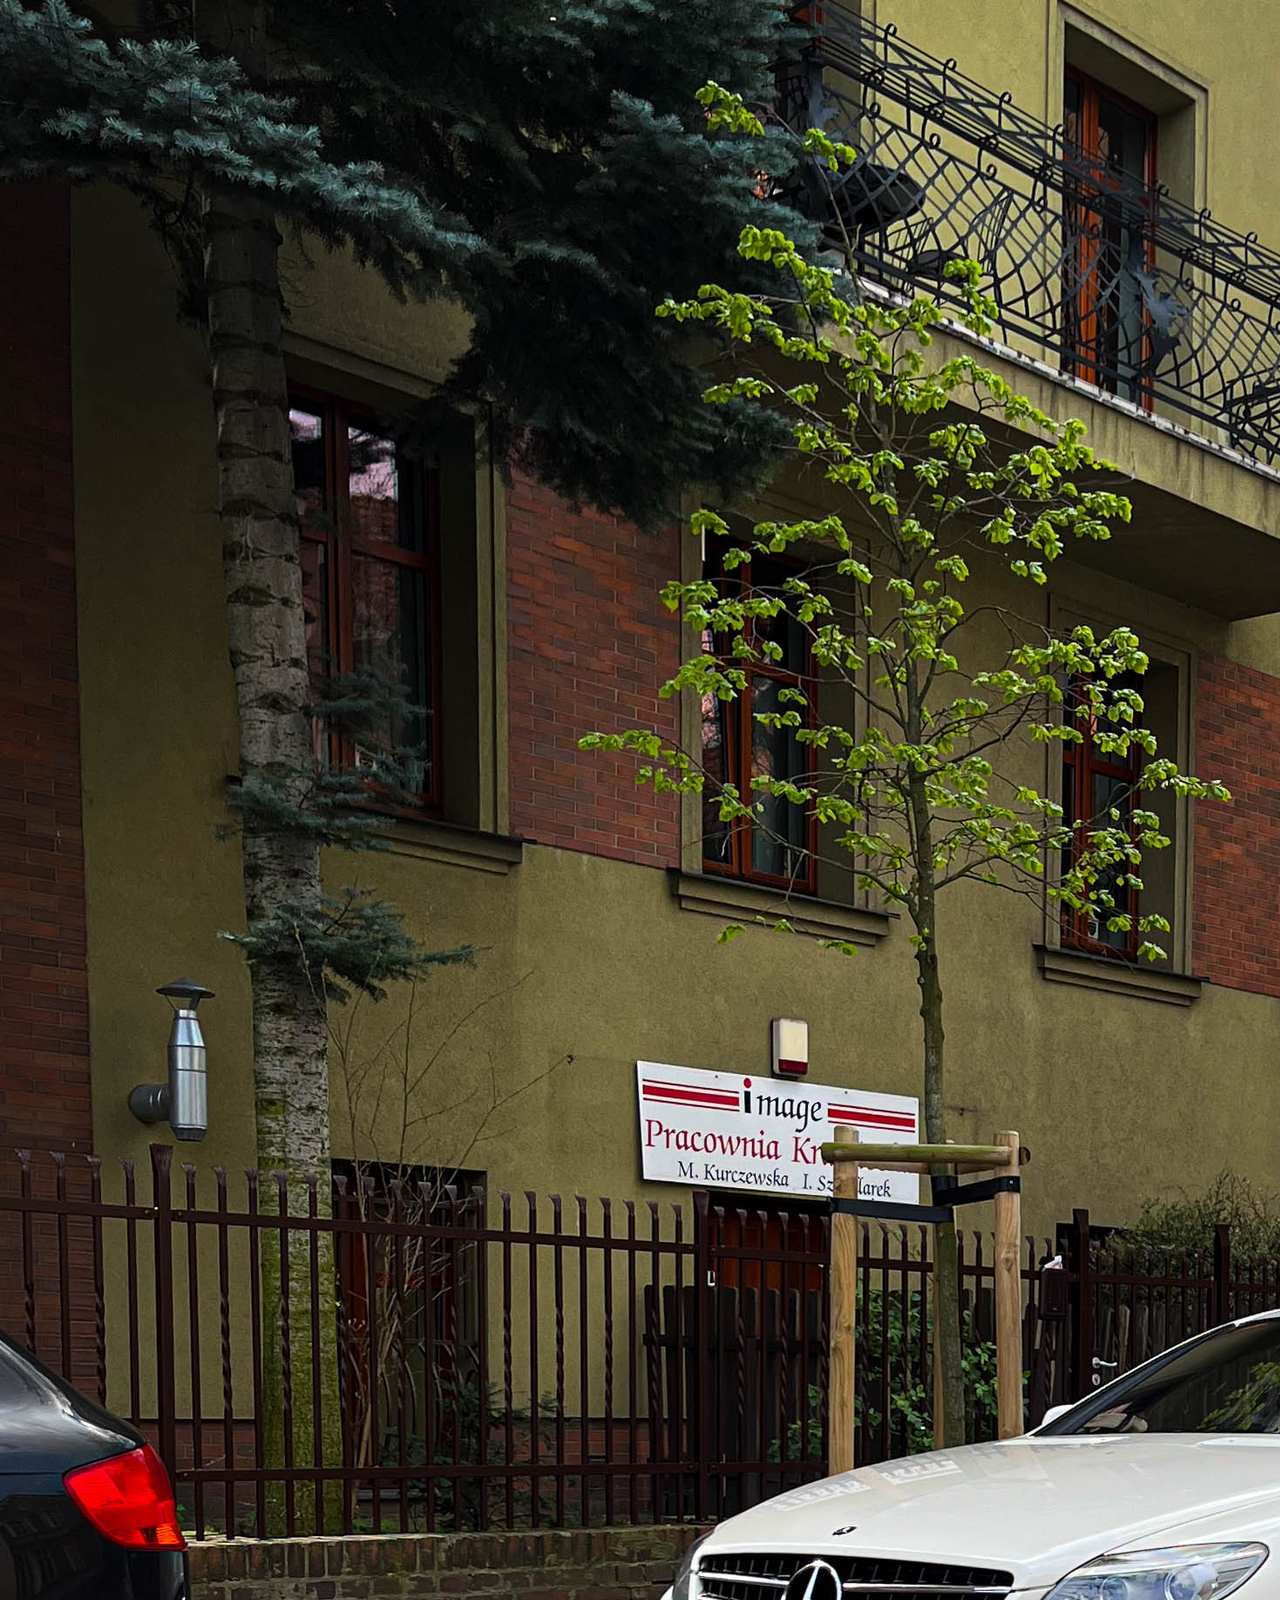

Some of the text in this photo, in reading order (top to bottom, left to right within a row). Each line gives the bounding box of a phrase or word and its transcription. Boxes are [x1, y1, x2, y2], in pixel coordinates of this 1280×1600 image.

[743, 1078, 823, 1132] image
[645, 1119, 781, 1160] Pracownia
[678, 1161, 699, 1179] M.
[704, 1163, 789, 1187] Kurczewska
[803, 1173, 813, 1190] I.
